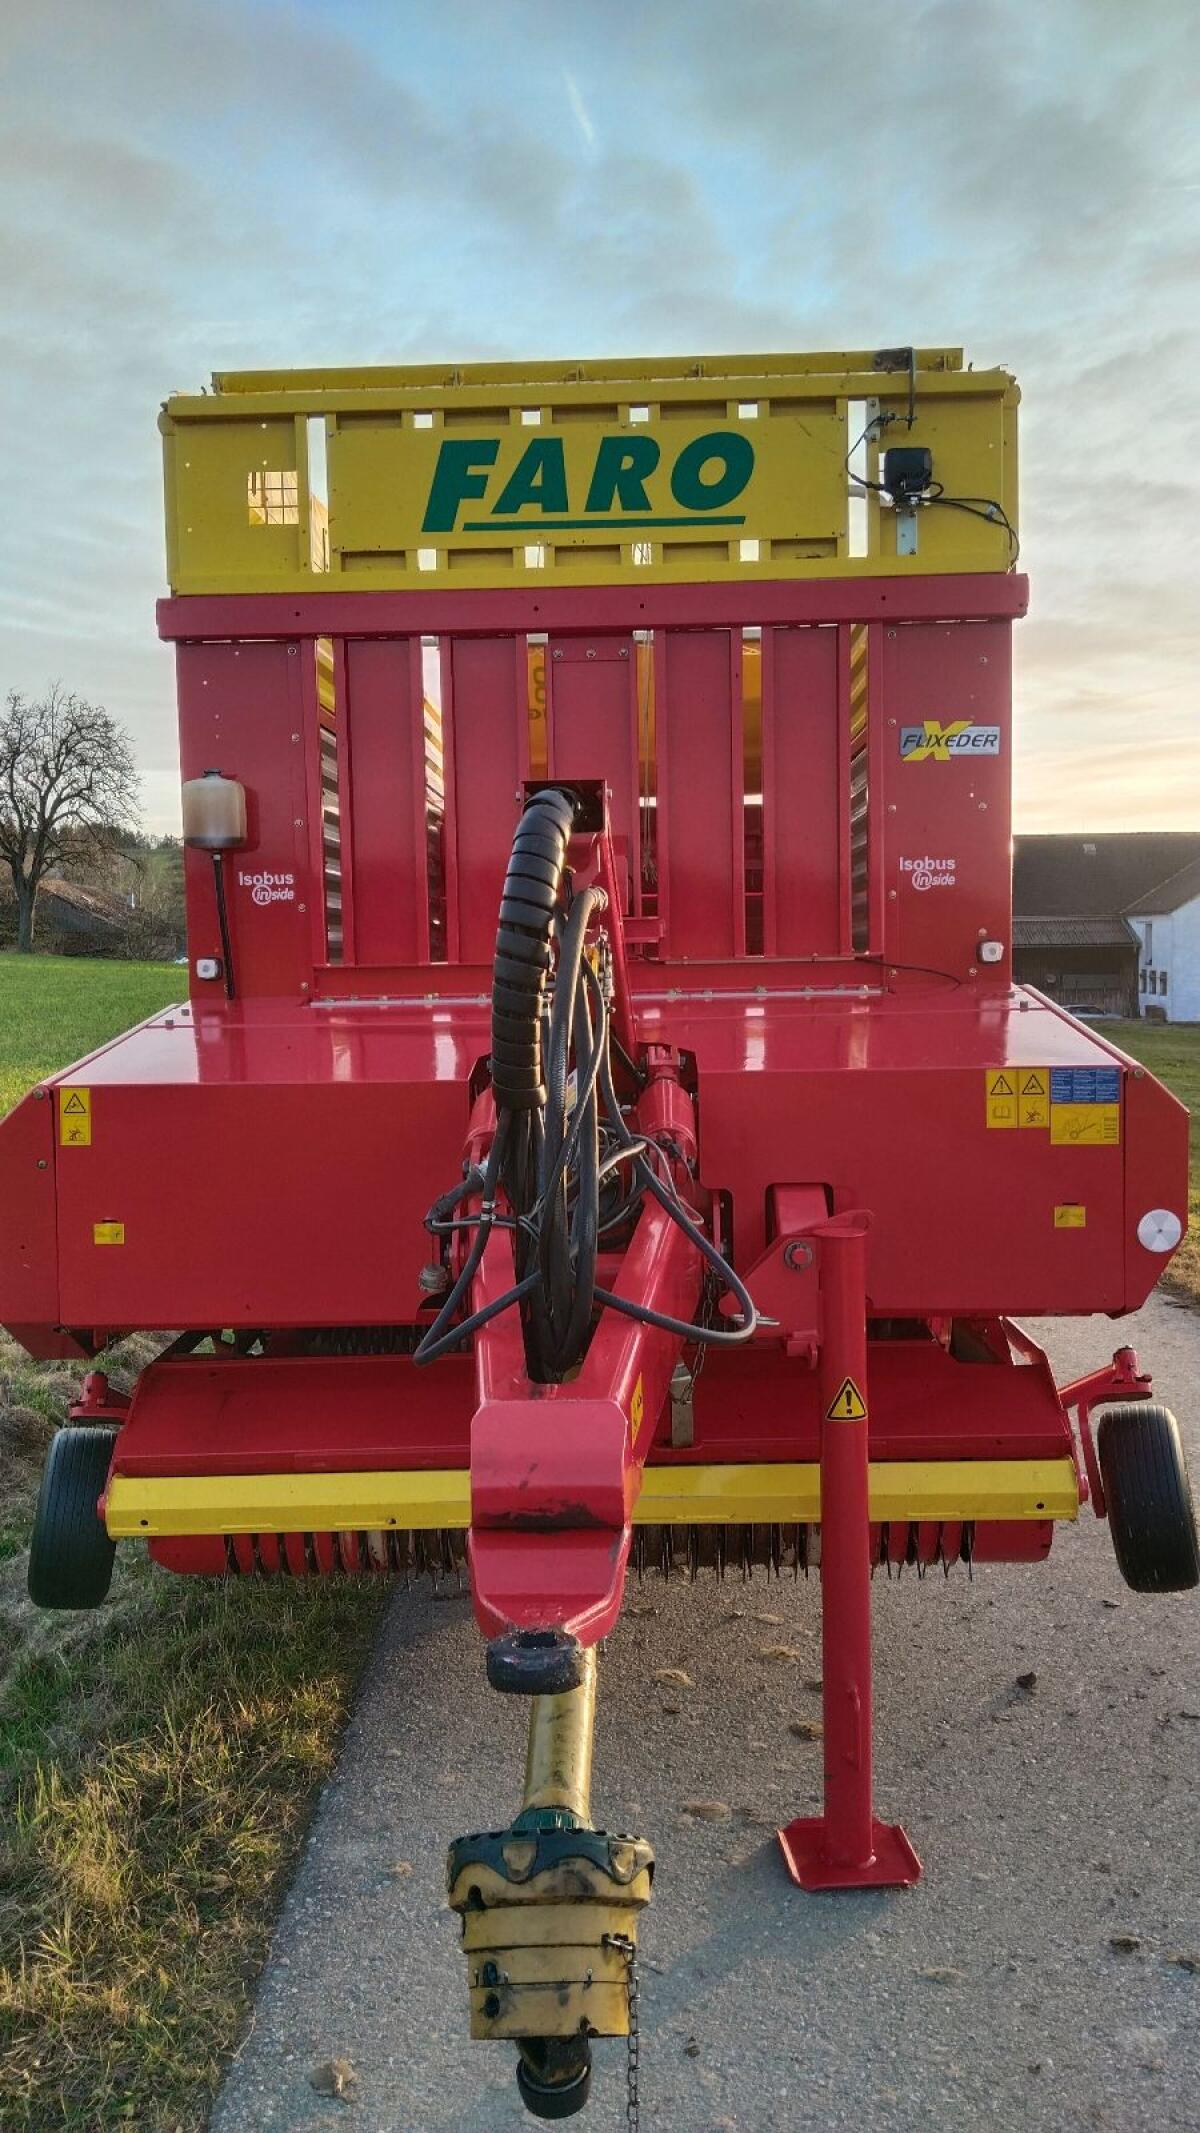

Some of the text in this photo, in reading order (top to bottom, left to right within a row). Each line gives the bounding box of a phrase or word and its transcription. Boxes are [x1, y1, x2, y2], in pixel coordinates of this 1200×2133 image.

[421, 432, 755, 532] FARO
[902, 733, 998, 748] FLIXEDER
[900, 857, 956, 870] Isobus
[239, 872, 294, 886] Isobus
[912, 870, 956, 890] inside
[252, 885, 294, 905] inside
